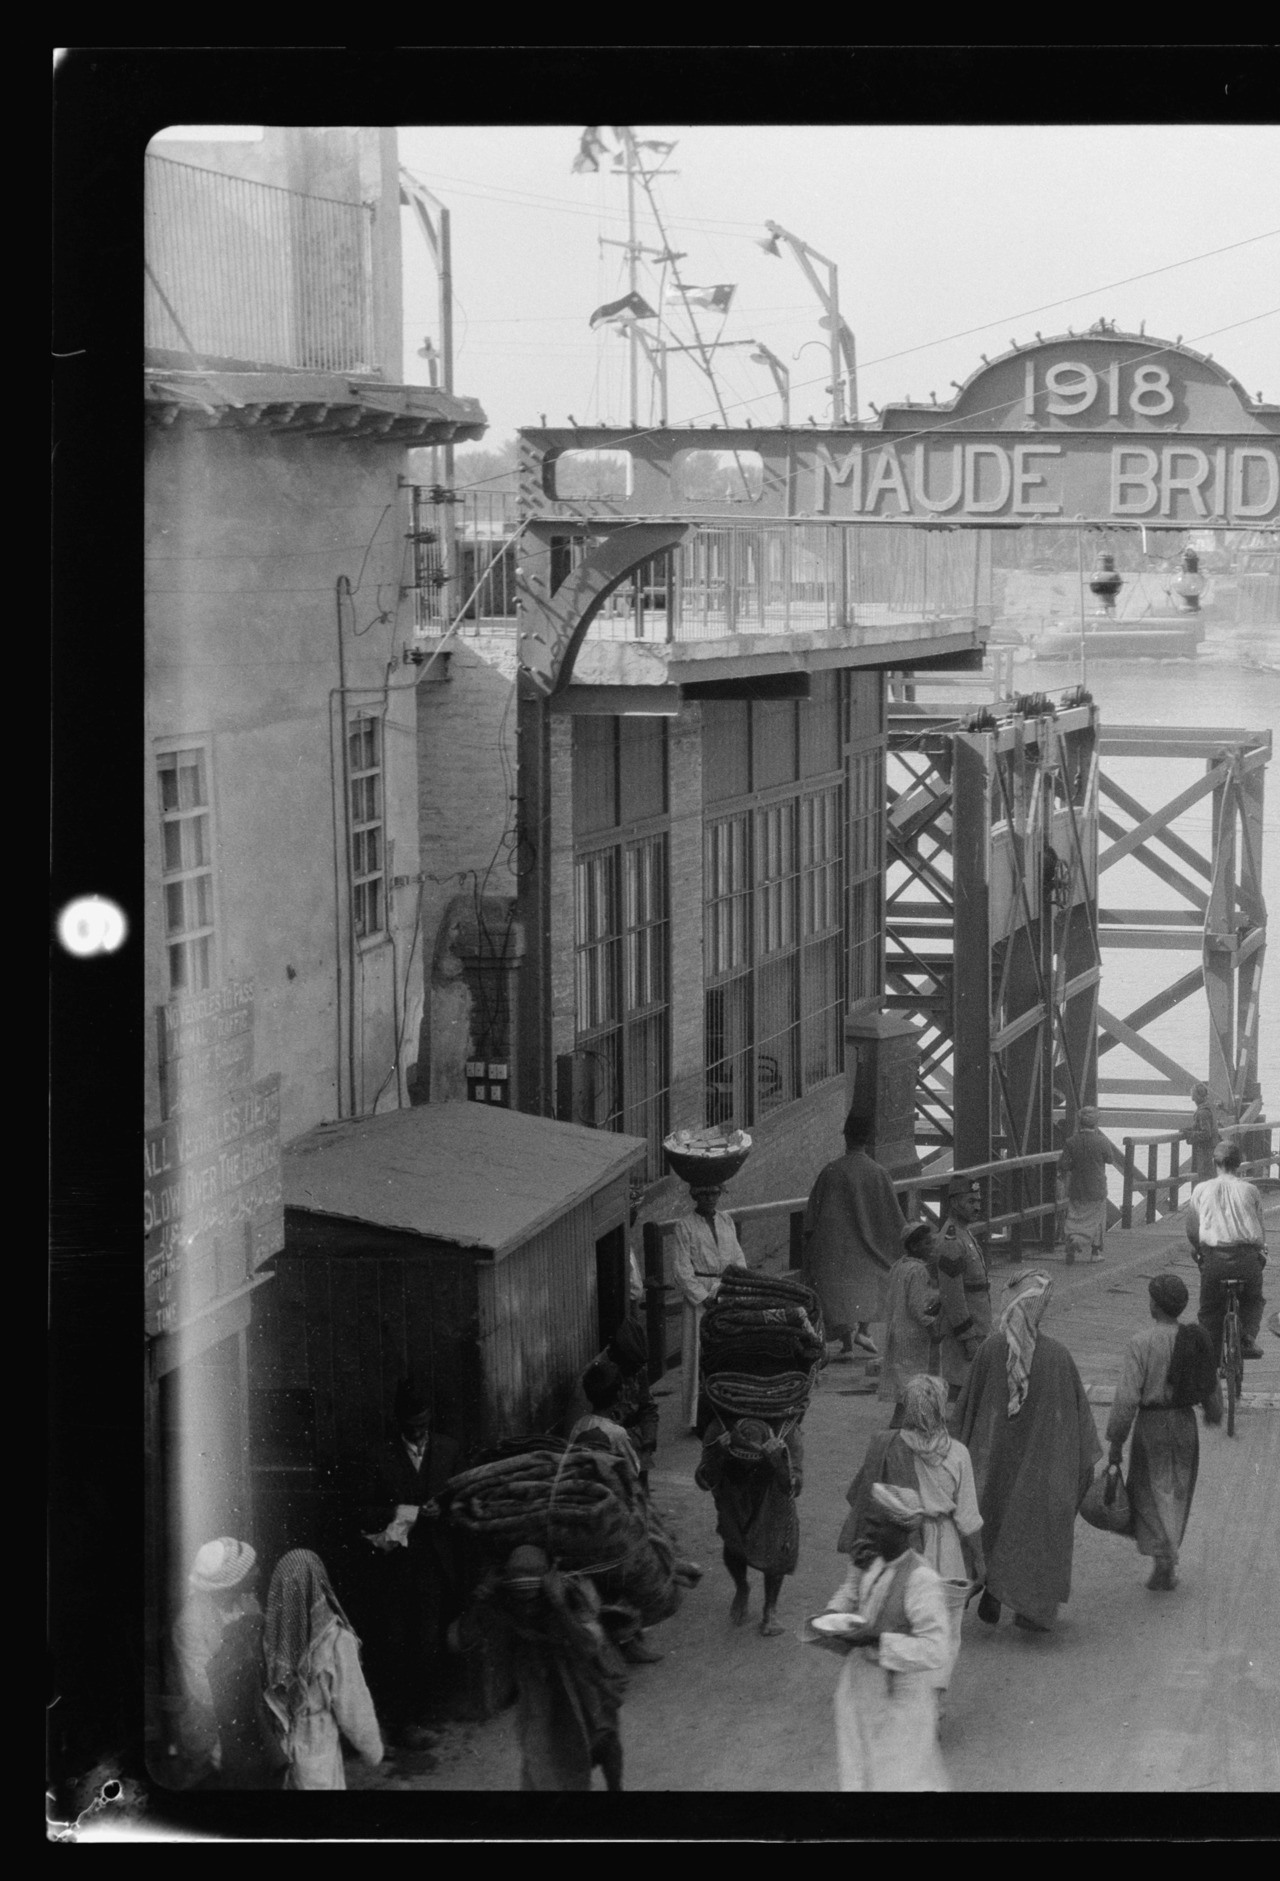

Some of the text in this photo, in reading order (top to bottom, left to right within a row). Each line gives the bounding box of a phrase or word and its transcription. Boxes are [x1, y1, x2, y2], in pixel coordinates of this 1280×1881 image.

[1023, 361, 1175, 416] 1918
[814, 443, 1062, 514] MAUDE
[176, 1107, 240, 1163] VEHICLES
[144, 1183, 180, 1231] SLOW
[184, 1165, 218, 1213] OVER
[219, 1152, 241, 1196] THE
[156, 1301, 178, 1333] TIME
